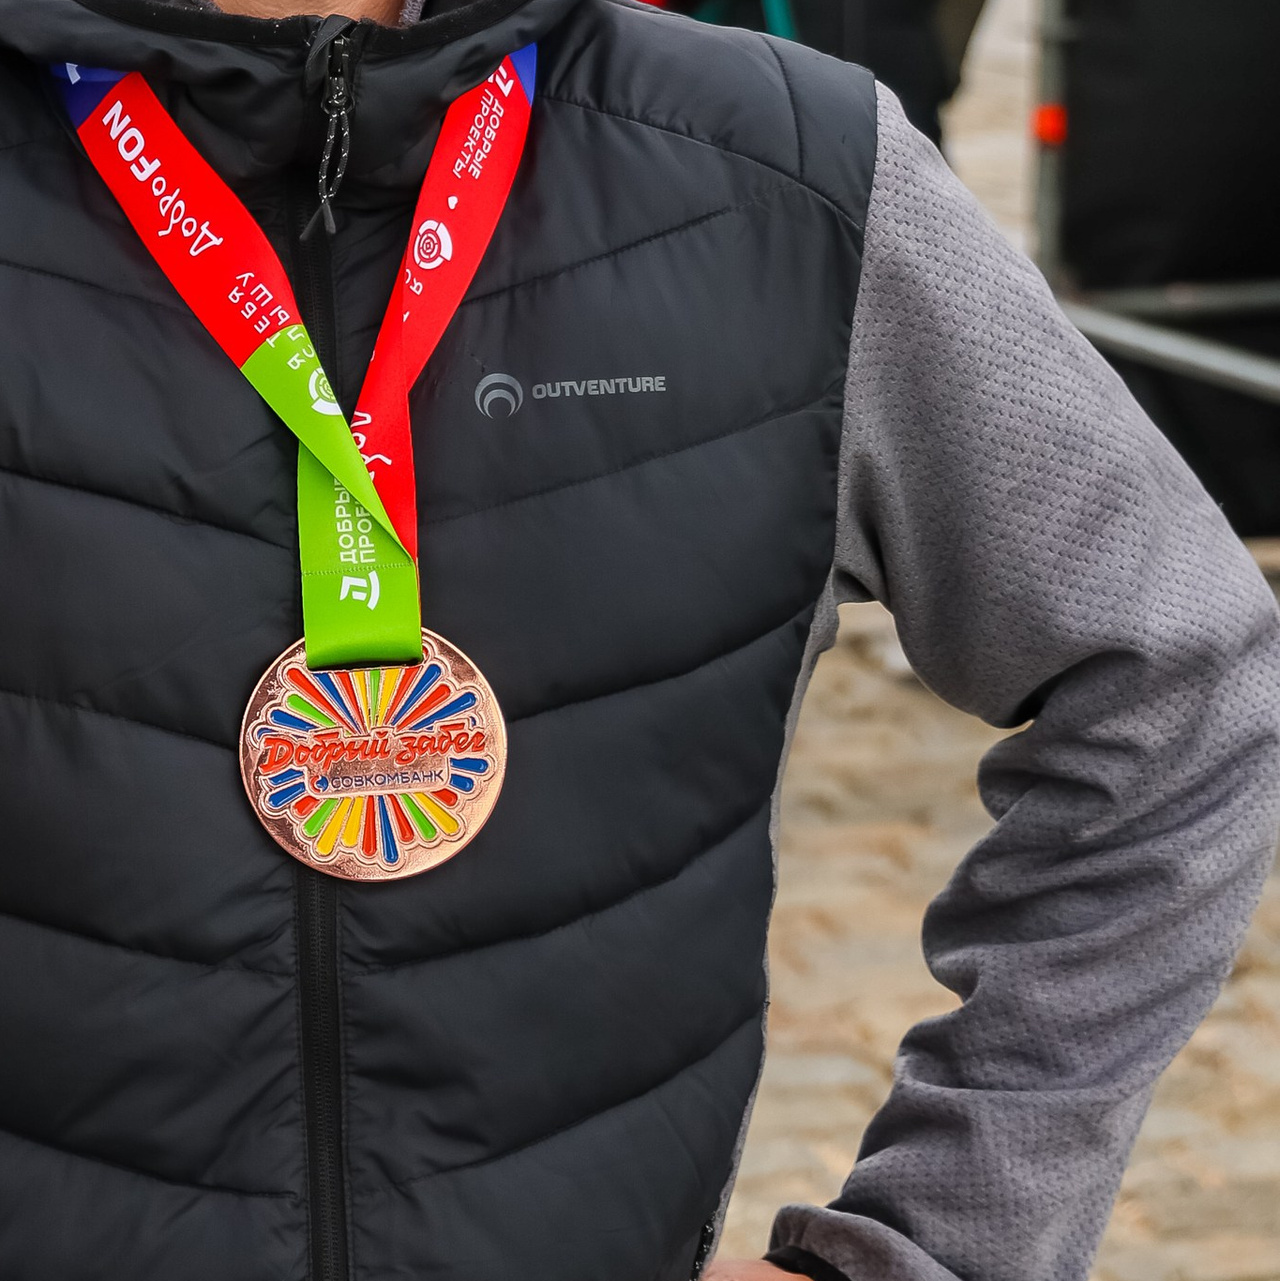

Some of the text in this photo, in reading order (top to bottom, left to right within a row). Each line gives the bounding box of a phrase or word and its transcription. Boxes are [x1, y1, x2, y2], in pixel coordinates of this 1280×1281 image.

[452, 88, 493, 179] ПРОЕКТЫ
[467, 97, 505, 180] ДОБРЫЕ
[532, 376, 667, 400] OUTVENTURE
[258, 730, 392, 775] Добрый
[330, 770, 445, 789] СОВКОМБАНК
